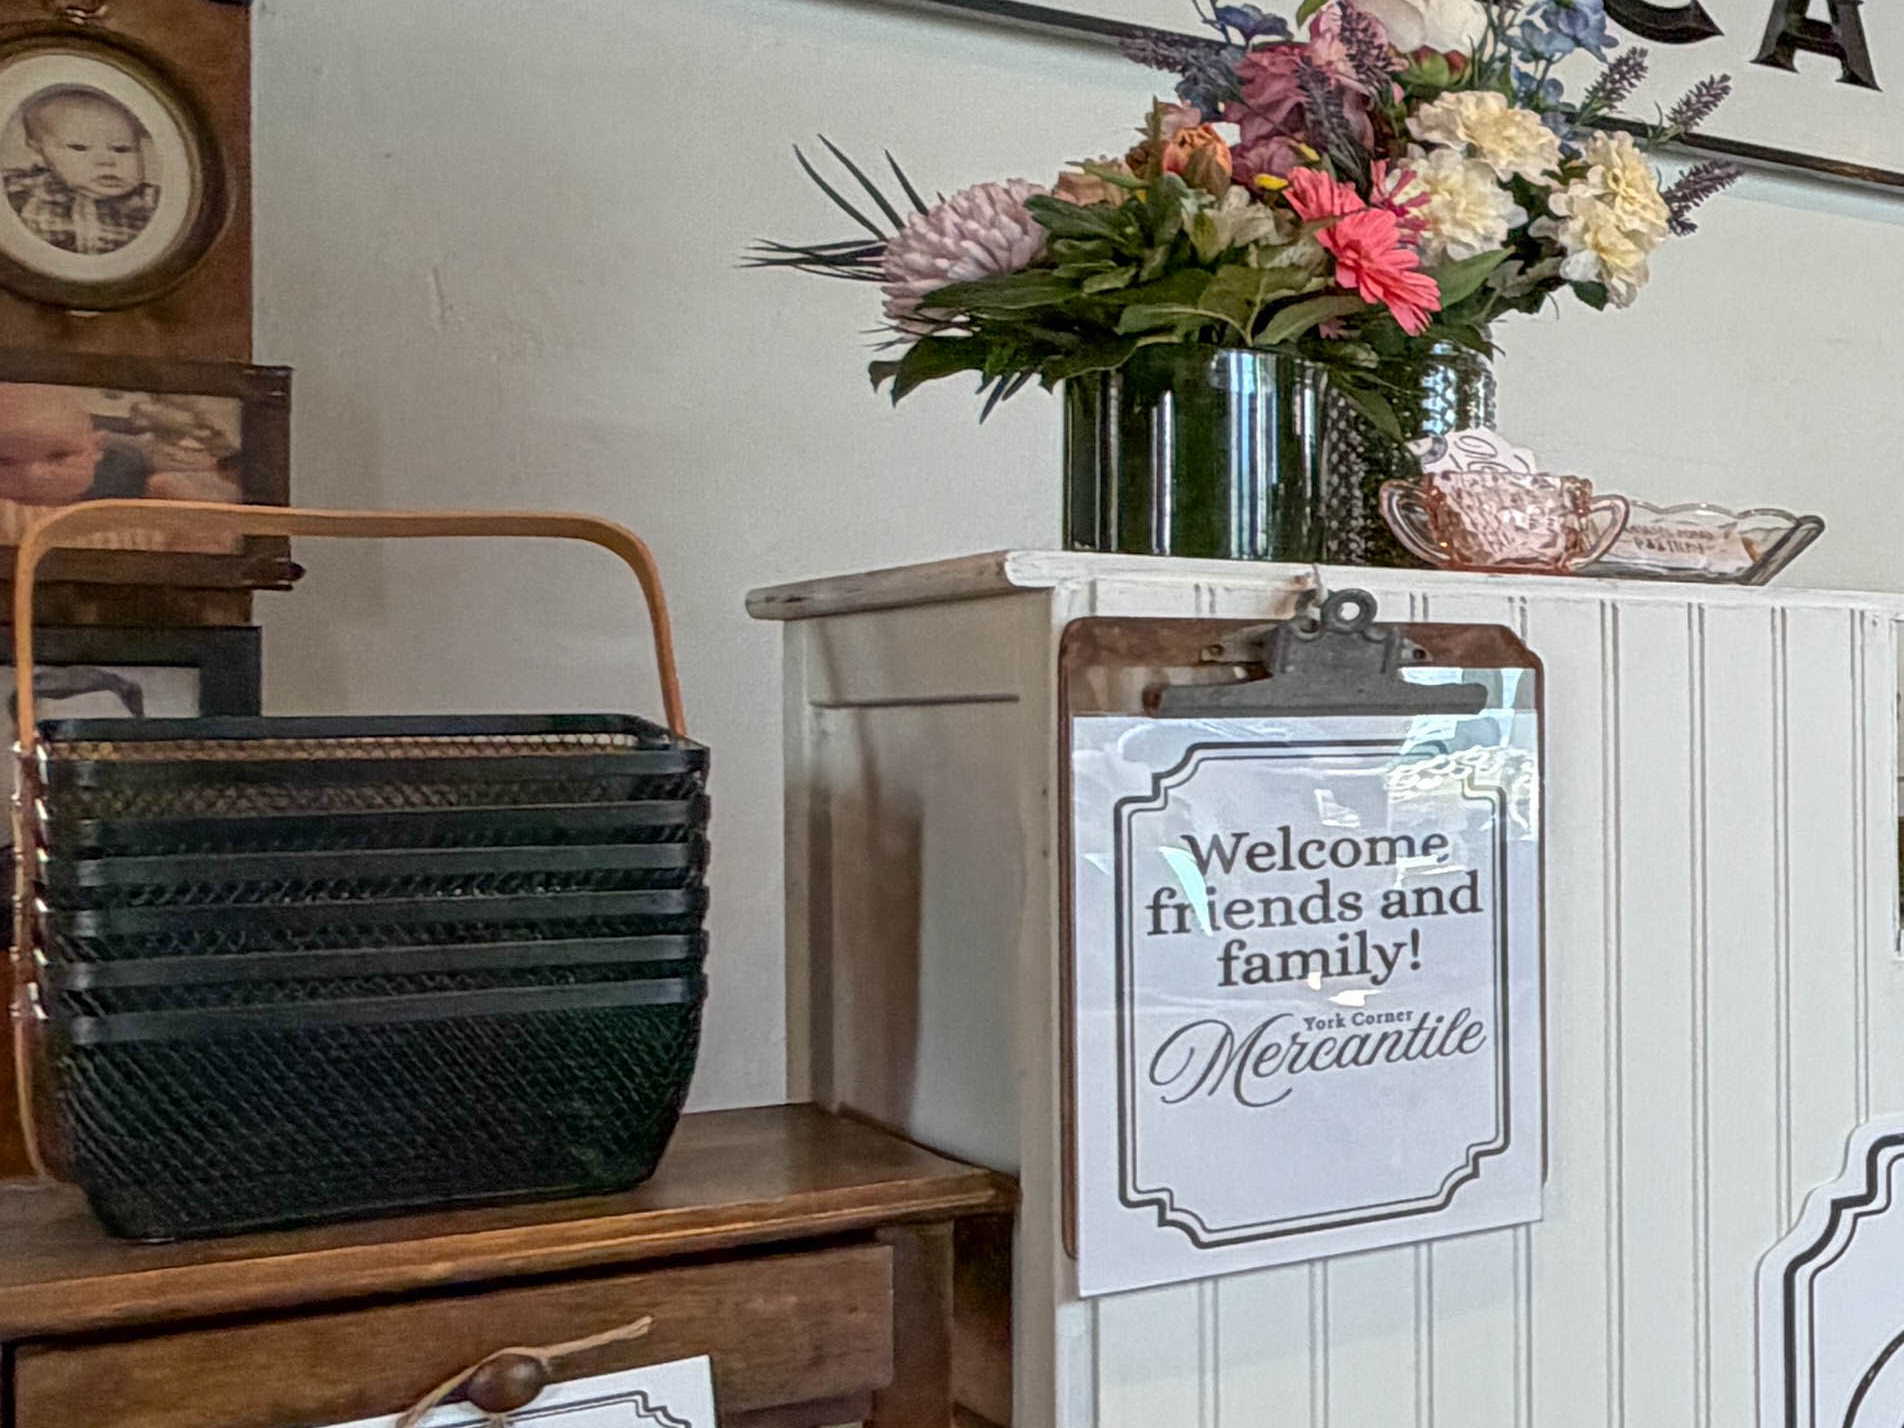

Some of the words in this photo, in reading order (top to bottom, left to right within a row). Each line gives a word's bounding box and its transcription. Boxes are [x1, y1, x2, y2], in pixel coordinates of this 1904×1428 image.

[1181, 825, 1449, 876] Welcome
[1146, 878, 1363, 936] friends
[1380, 870, 1483, 918] and
[1217, 929, 1422, 987] family!
[1303, 1014, 1346, 1032] York
[1352, 1008, 1413, 1029] Corner
[1149, 1007, 1487, 1107] Mercantile
